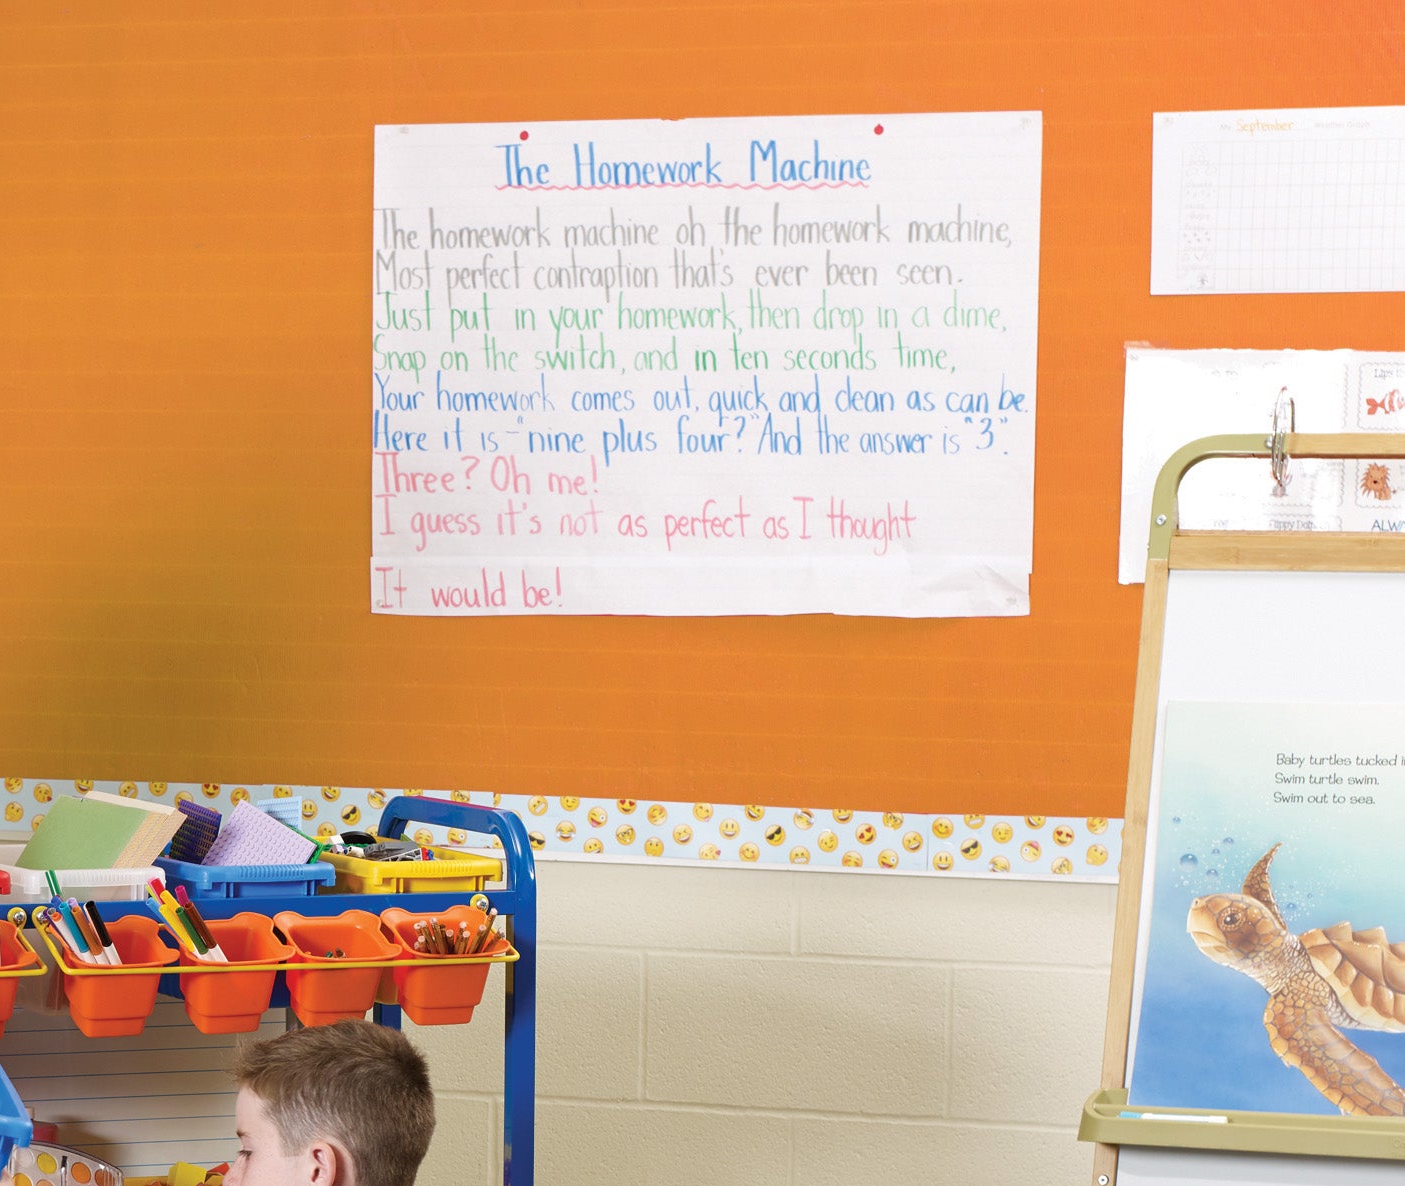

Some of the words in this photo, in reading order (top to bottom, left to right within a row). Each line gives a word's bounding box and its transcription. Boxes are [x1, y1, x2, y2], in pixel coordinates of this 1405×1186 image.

[1236, 118, 1295, 136] September
[497, 143, 551, 187] The
[574, 143, 722, 184] Homework
[749, 140, 872, 183] Machine
[380, 208, 421, 249] The
[430, 208, 551, 248] homework
[564, 208, 660, 247] machine
[676, 206, 707, 247] oh
[723, 204, 761, 247] the
[772, 203, 891, 245] homework
[907, 204, 1012, 248] machine,
[376, 250, 431, 295] Most
[446, 251, 523, 309] perfect
[533, 252, 658, 302] contraption
[673, 248, 733, 287] that's
[755, 261, 809, 287] ever
[825, 250, 877, 287] been
[897, 262, 963, 287] seen.
[376, 291, 431, 332] Just
[449, 292, 492, 342] put
[515, 300, 536, 332] in
[550, 306, 603, 350] your
[617, 295, 742, 335] homework,
[747, 291, 800, 331] then
[813, 290, 865, 344] drop
[878, 298, 898, 330] in
[912, 304, 930, 329] a
[943, 289, 1008, 334] dime,
[374, 335, 427, 383] Snap
[440, 348, 469, 372] on
[482, 337, 519, 373] the
[534, 334, 626, 376] switch,
[634, 336, 676, 372] and
[695, 342, 718, 372] in
[730, 333, 769, 372] ten
[784, 334, 877, 371] seconds
[896, 332, 955, 374] time,
[375, 373, 425, 414] Your
[436, 371, 555, 414] homework
[570, 382, 636, 413] comes
[708, 375, 768, 427] quick
[779, 374, 820, 414] and
[834, 374, 895, 414] clean
[906, 390, 936, 414] as
[947, 389, 989, 413] can
[999, 375, 1029, 414] be.
[374, 412, 428, 453] Here
[442, 418, 464, 453] it
[480, 427, 499, 453] is
[602, 413, 657, 466] plus
[757, 414, 801, 456] And
[816, 413, 852, 455] the
[859, 427, 932, 456] answer
[941, 422, 959, 454] is
[377, 452, 480, 495] Three?
[489, 456, 531, 495] Oh
[548, 456, 601, 496] me!
[376, 495, 396, 536] I
[410, 507, 481, 552] guess
[497, 501, 543, 536] it's
[558, 501, 603, 537] not
[617, 512, 648, 538] as
[664, 498, 751, 549] perfect
[763, 512, 789, 539] as
[793, 497, 815, 538] I
[827, 499, 917, 555] thought
[376, 566, 407, 609] It
[430, 567, 507, 609] would
[522, 566, 564, 609] be!
[1275, 772, 1305, 784] Swim
[1309, 773, 1344, 785] turtle
[1348, 775, 1379, 785] swim.
[1276, 753, 1305, 768] Baby
[1310, 754, 1352, 766] turtles
[1356, 754, 1397, 766] tucked
[1274, 792, 1303, 803] Swim
[1307, 794, 1328, 803] out
[1333, 794, 1346, 804] to
[1350, 796, 1375, 804] sea.
